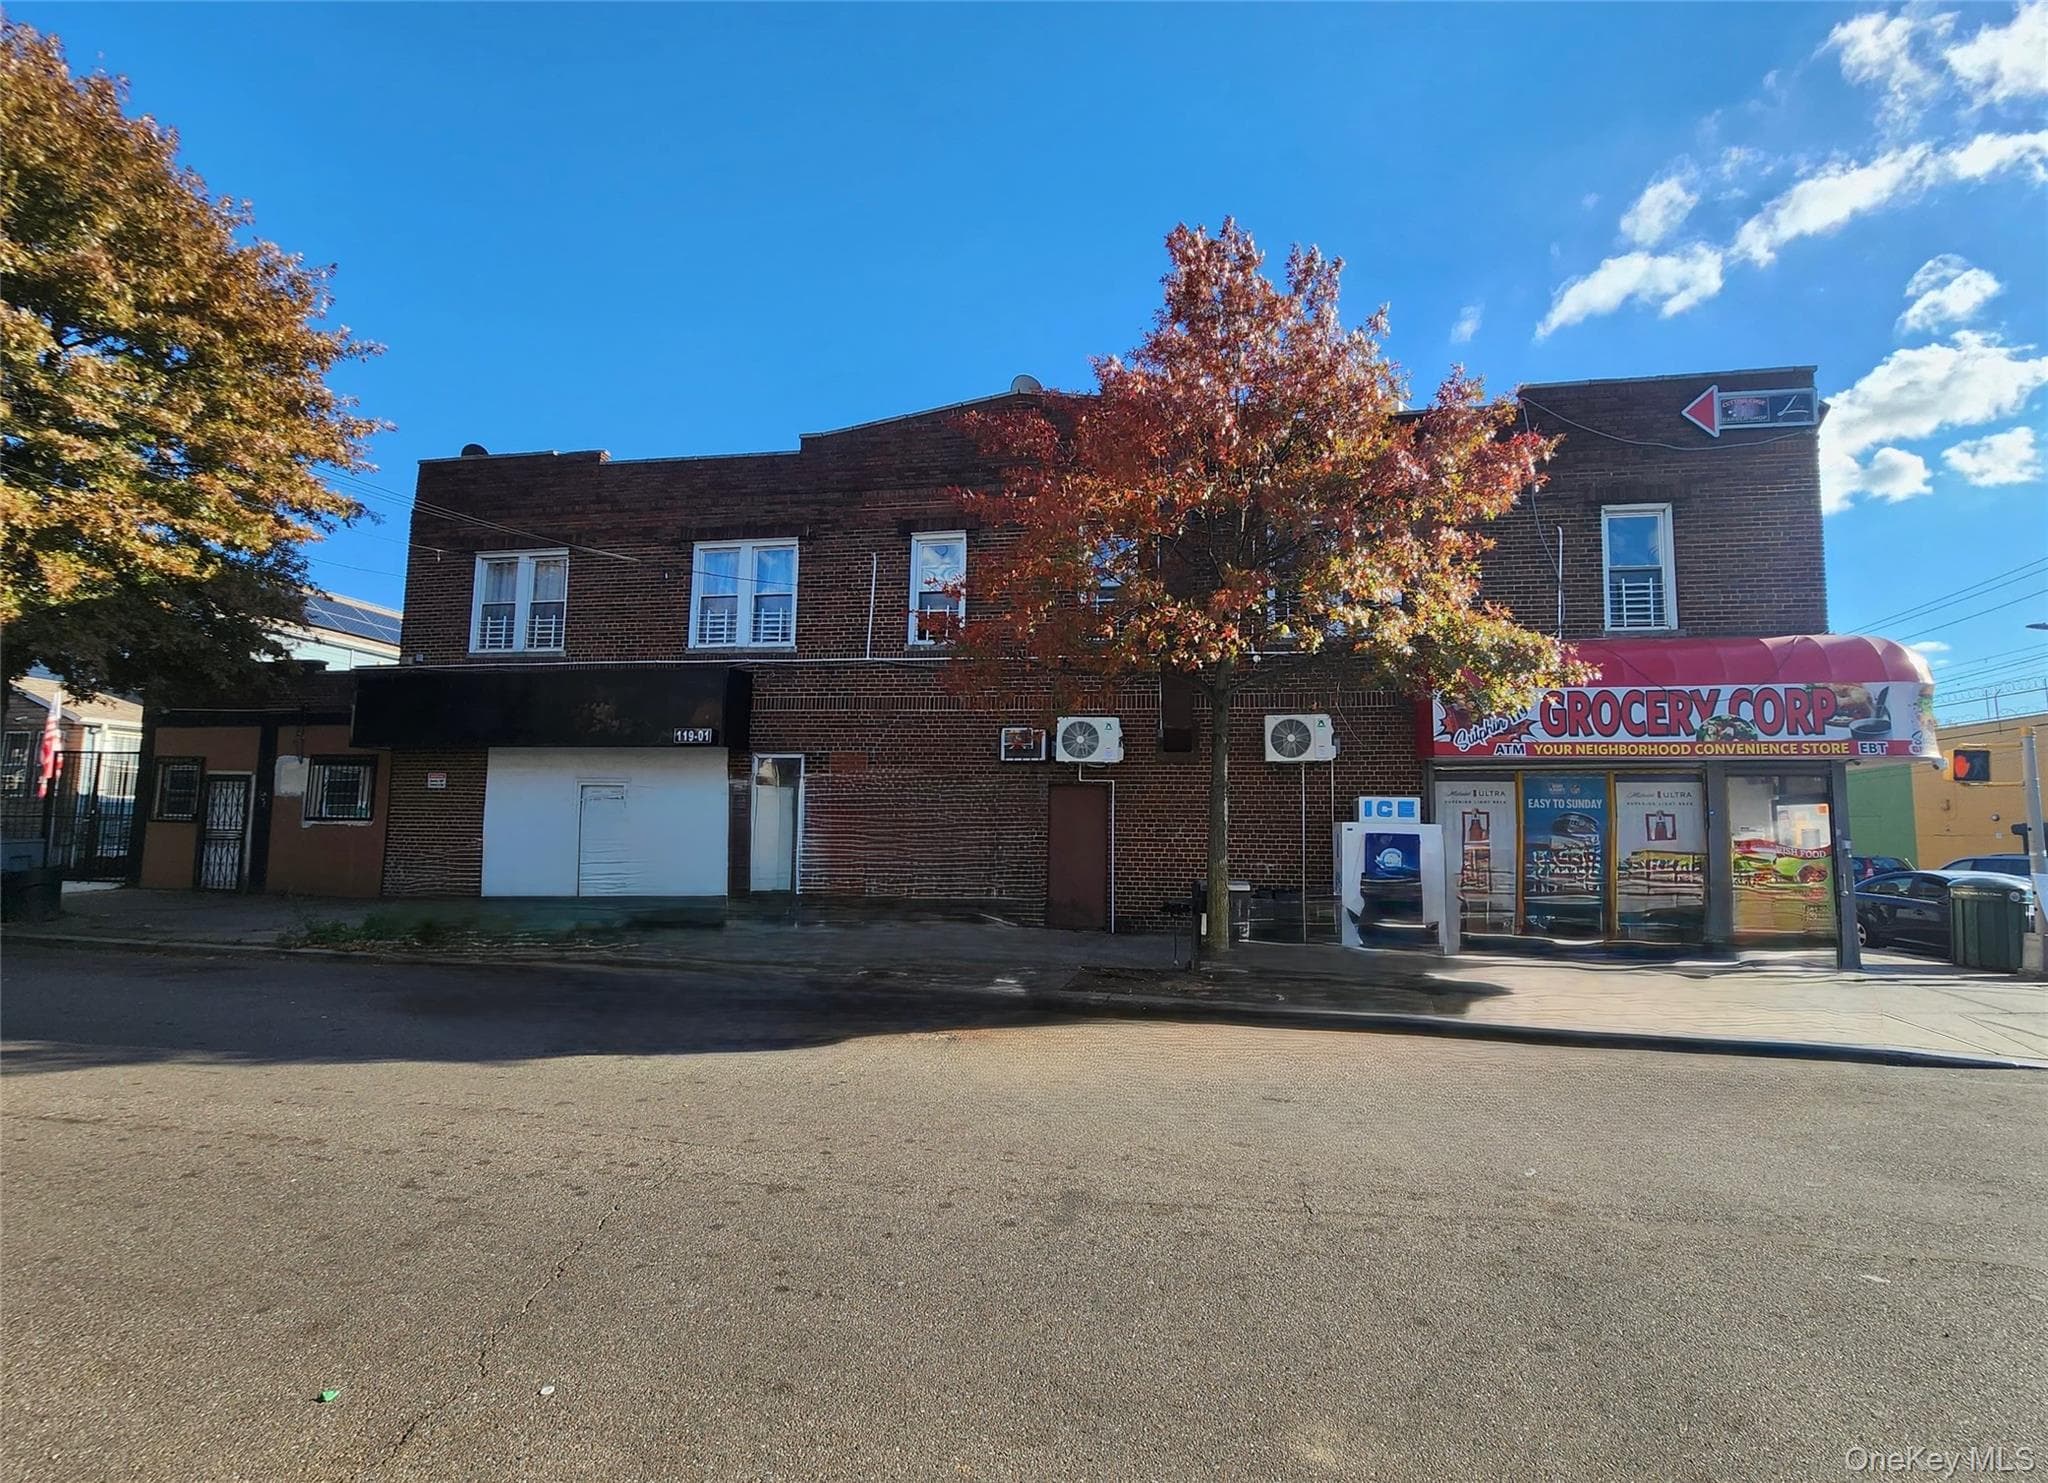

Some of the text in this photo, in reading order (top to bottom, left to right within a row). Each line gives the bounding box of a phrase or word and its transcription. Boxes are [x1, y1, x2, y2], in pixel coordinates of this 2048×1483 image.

[1540, 688, 1837, 737] GROCERY CORP
[677, 731, 709, 741] 119-01
[1495, 743, 1526, 756] ATM
[1534, 743, 1850, 756] YOUR NEIGHBORHOOD CONVENIENCE STORE
[1859, 742, 1888, 754] EBT
[1364, 800, 1415, 818] ICE
[1528, 798, 1602, 809] EASY TO SUNDAY
[1800, 850, 1826, 859] FOOD
